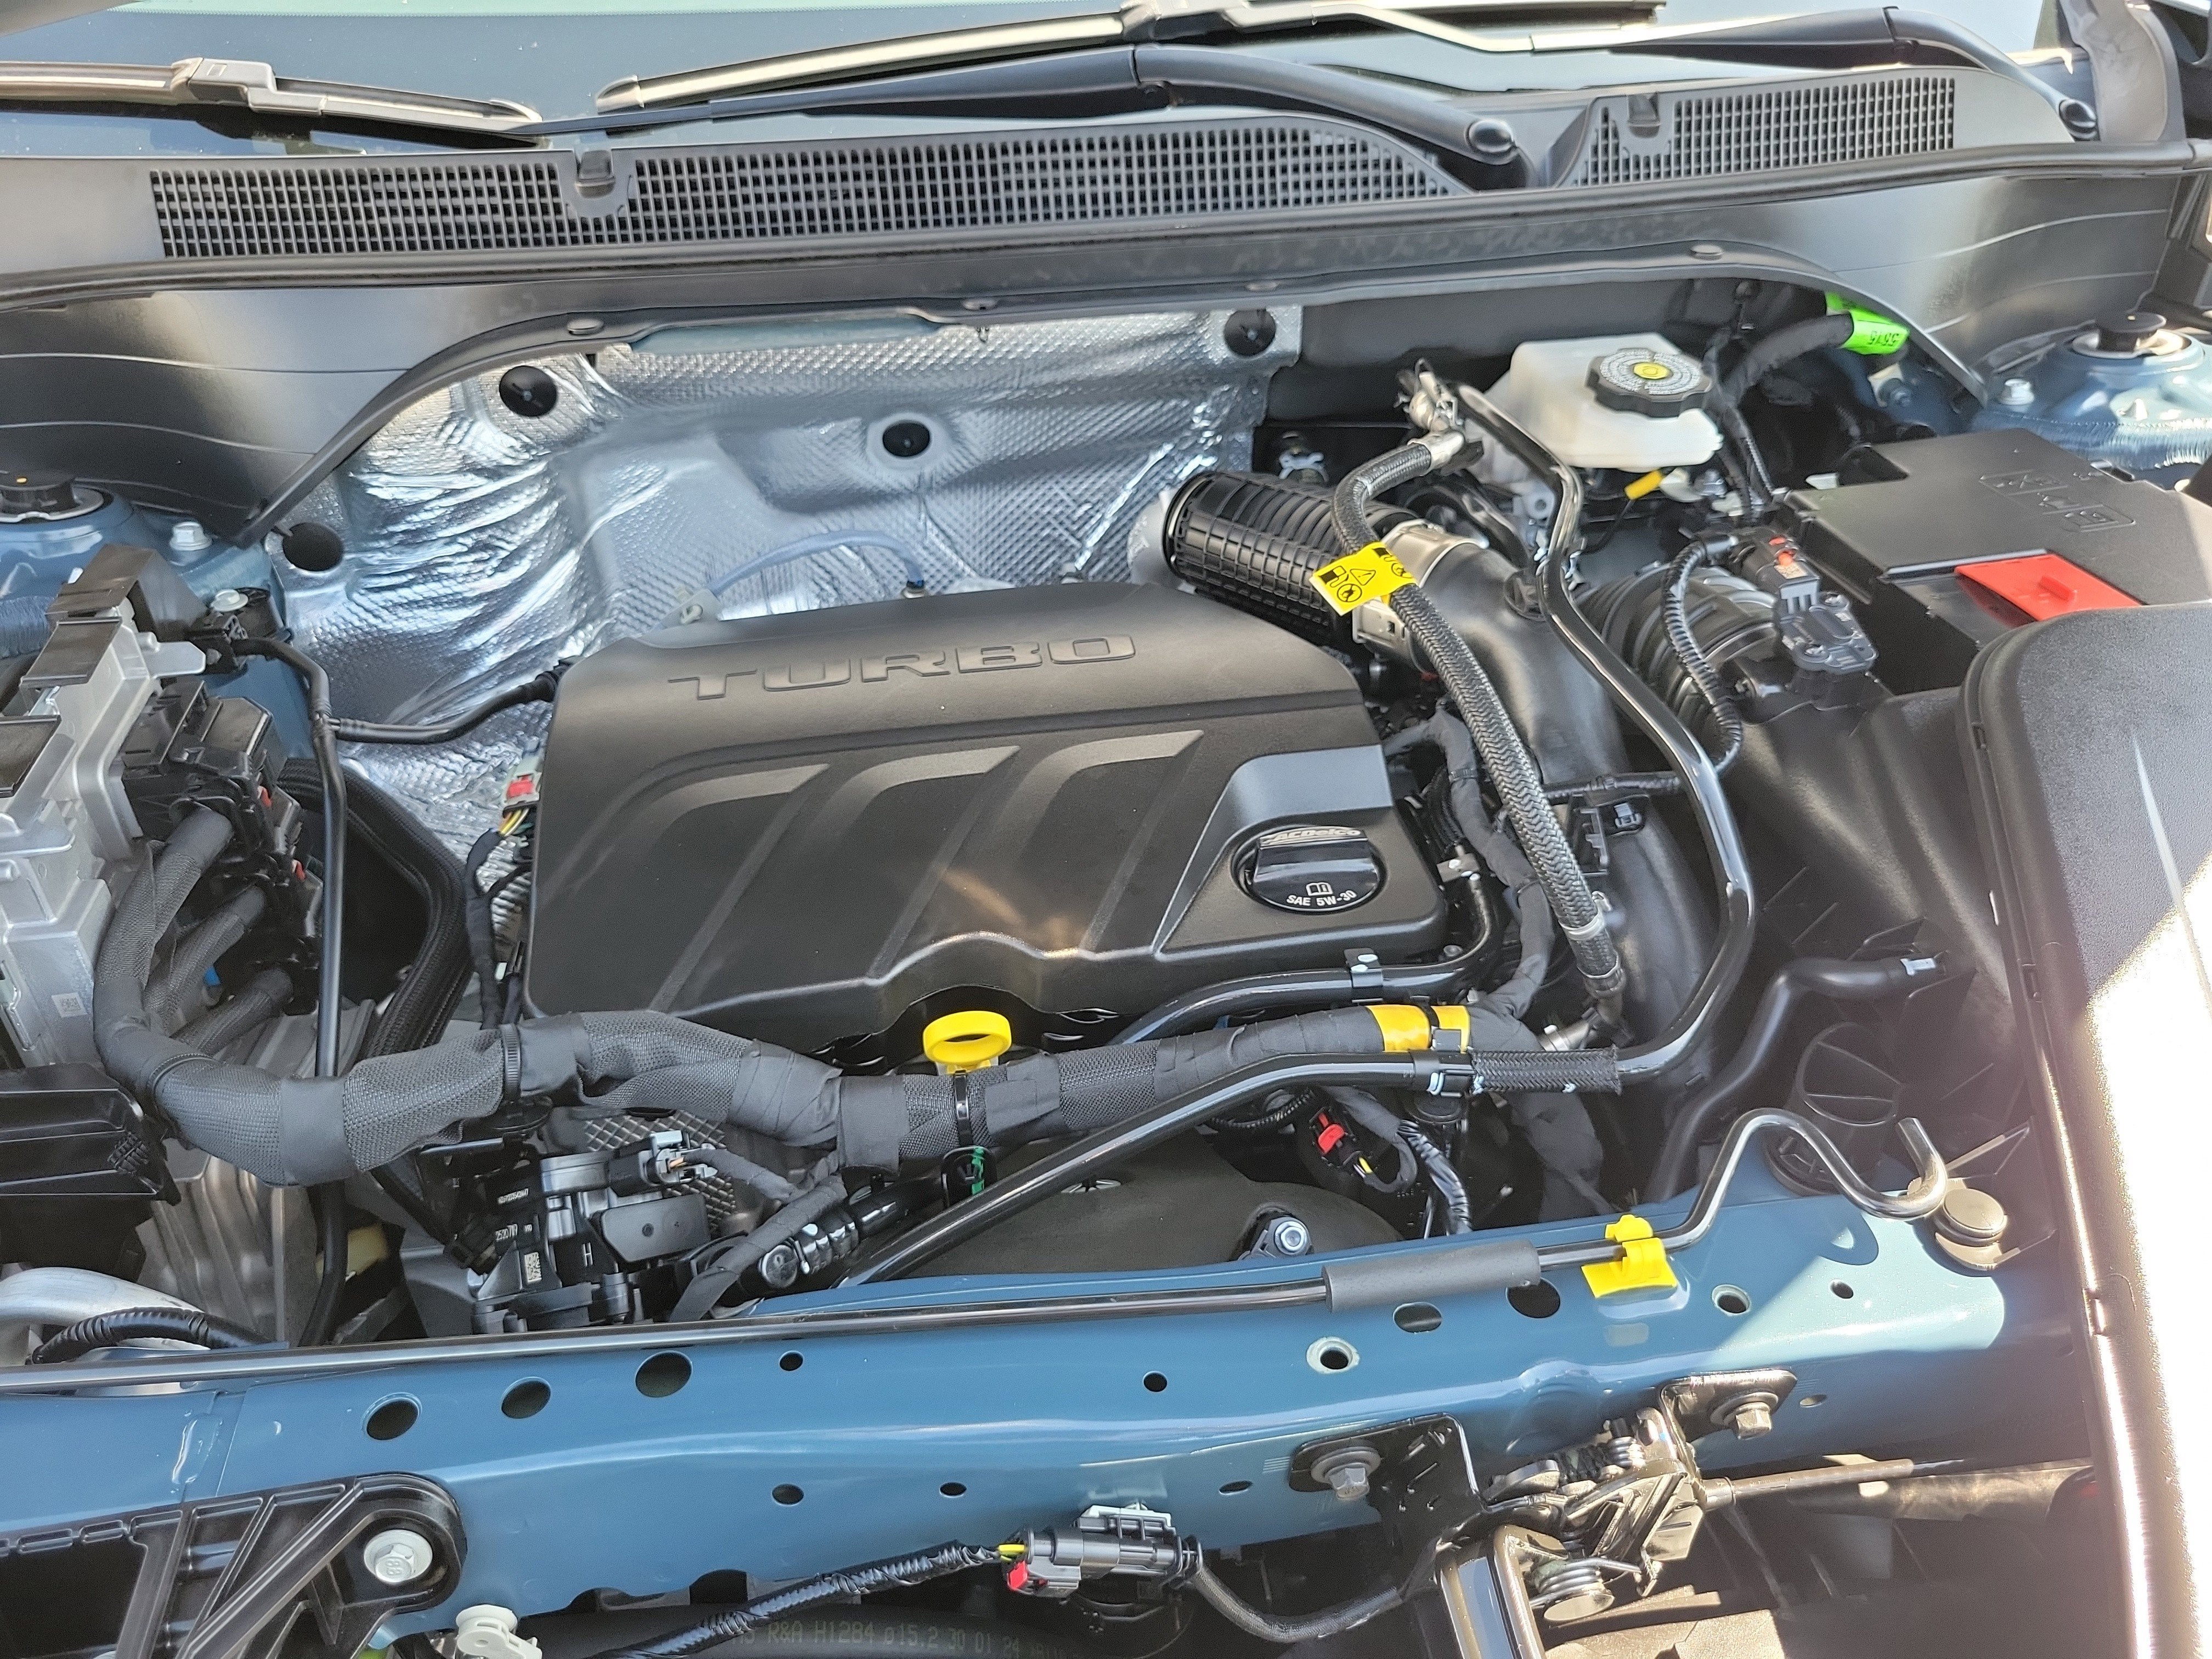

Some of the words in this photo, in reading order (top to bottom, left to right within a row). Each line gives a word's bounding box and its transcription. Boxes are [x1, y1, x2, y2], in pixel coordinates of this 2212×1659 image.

[667, 635, 1136, 701] TURBO
[1273, 829, 1361, 840] ACDelco
[1286, 895, 1311, 906] SAE
[1316, 889, 1357, 906] 5W-30
[768, 1620, 803, 1644] R&A
[815, 1620, 875, 1644] H1284
